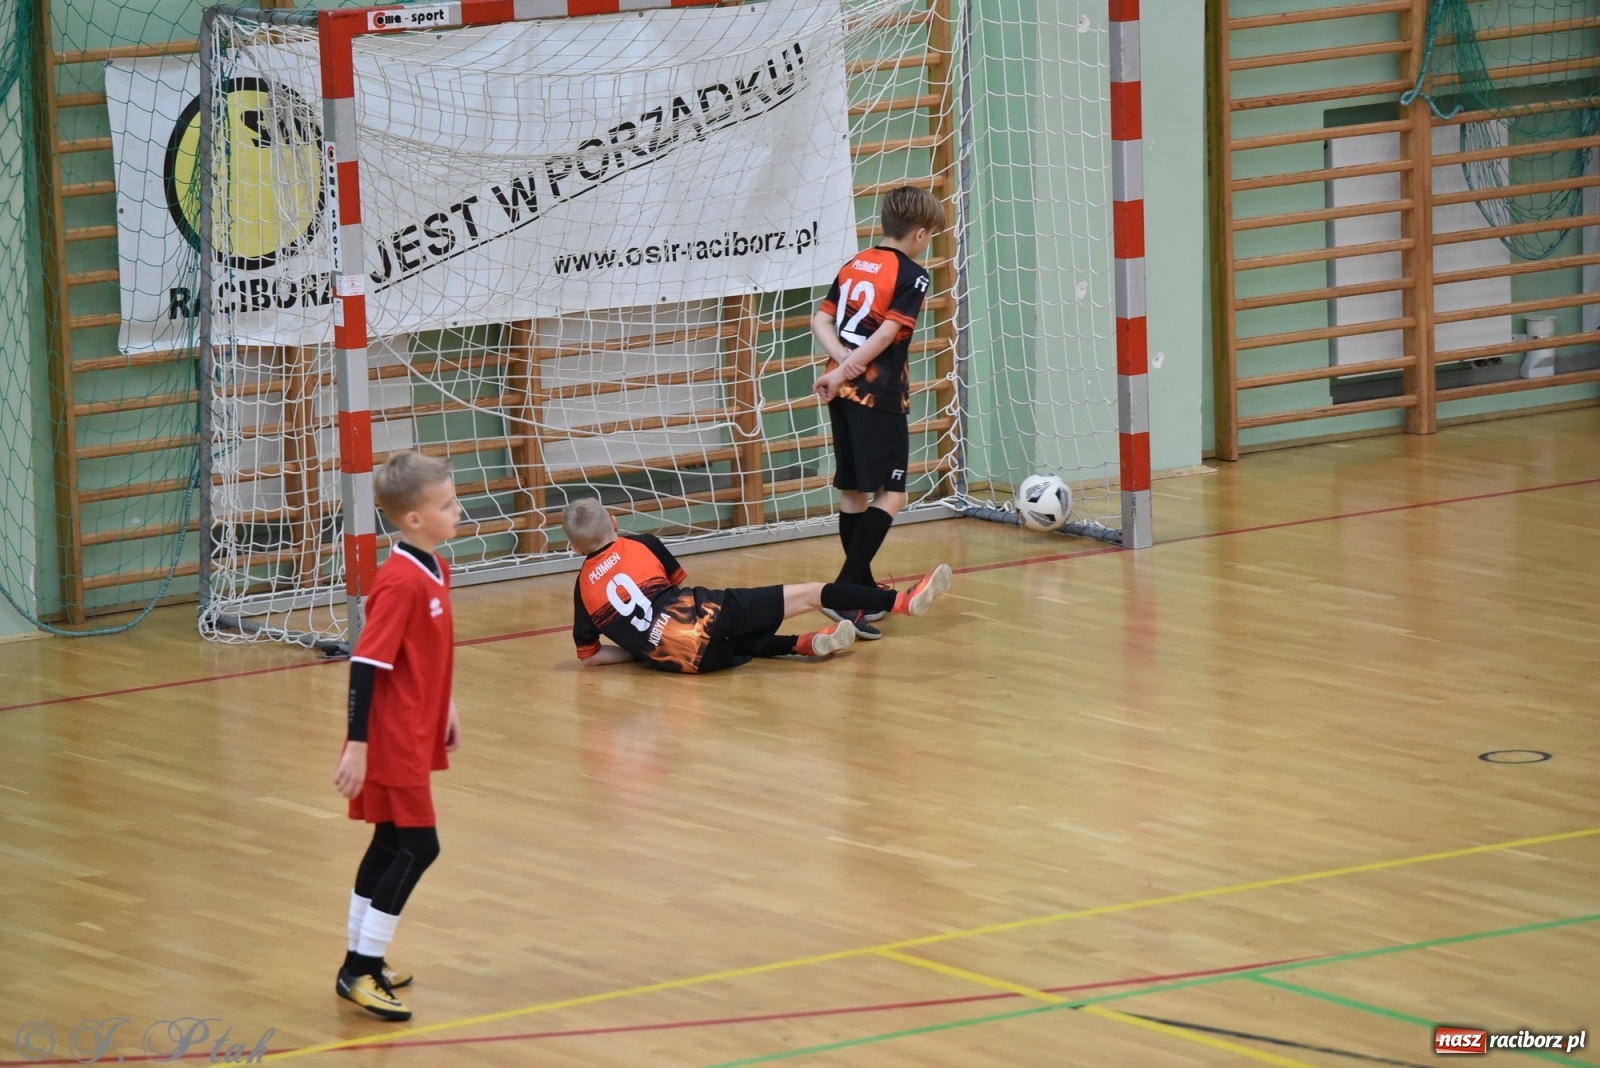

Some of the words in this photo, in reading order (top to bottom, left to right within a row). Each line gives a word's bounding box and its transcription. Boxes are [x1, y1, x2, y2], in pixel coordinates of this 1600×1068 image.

[411, 9, 445, 24] sport
[331, 209, 339, 269] sport
[369, 195, 479, 284] JEST
[491, 171, 538, 223] W
[552, 221, 820, 275] www.osir-raciborz.pl
[835, 278, 876, 347] 12
[588, 551, 622, 585] PŁOMIEŃ
[605, 572, 654, 632] 9
